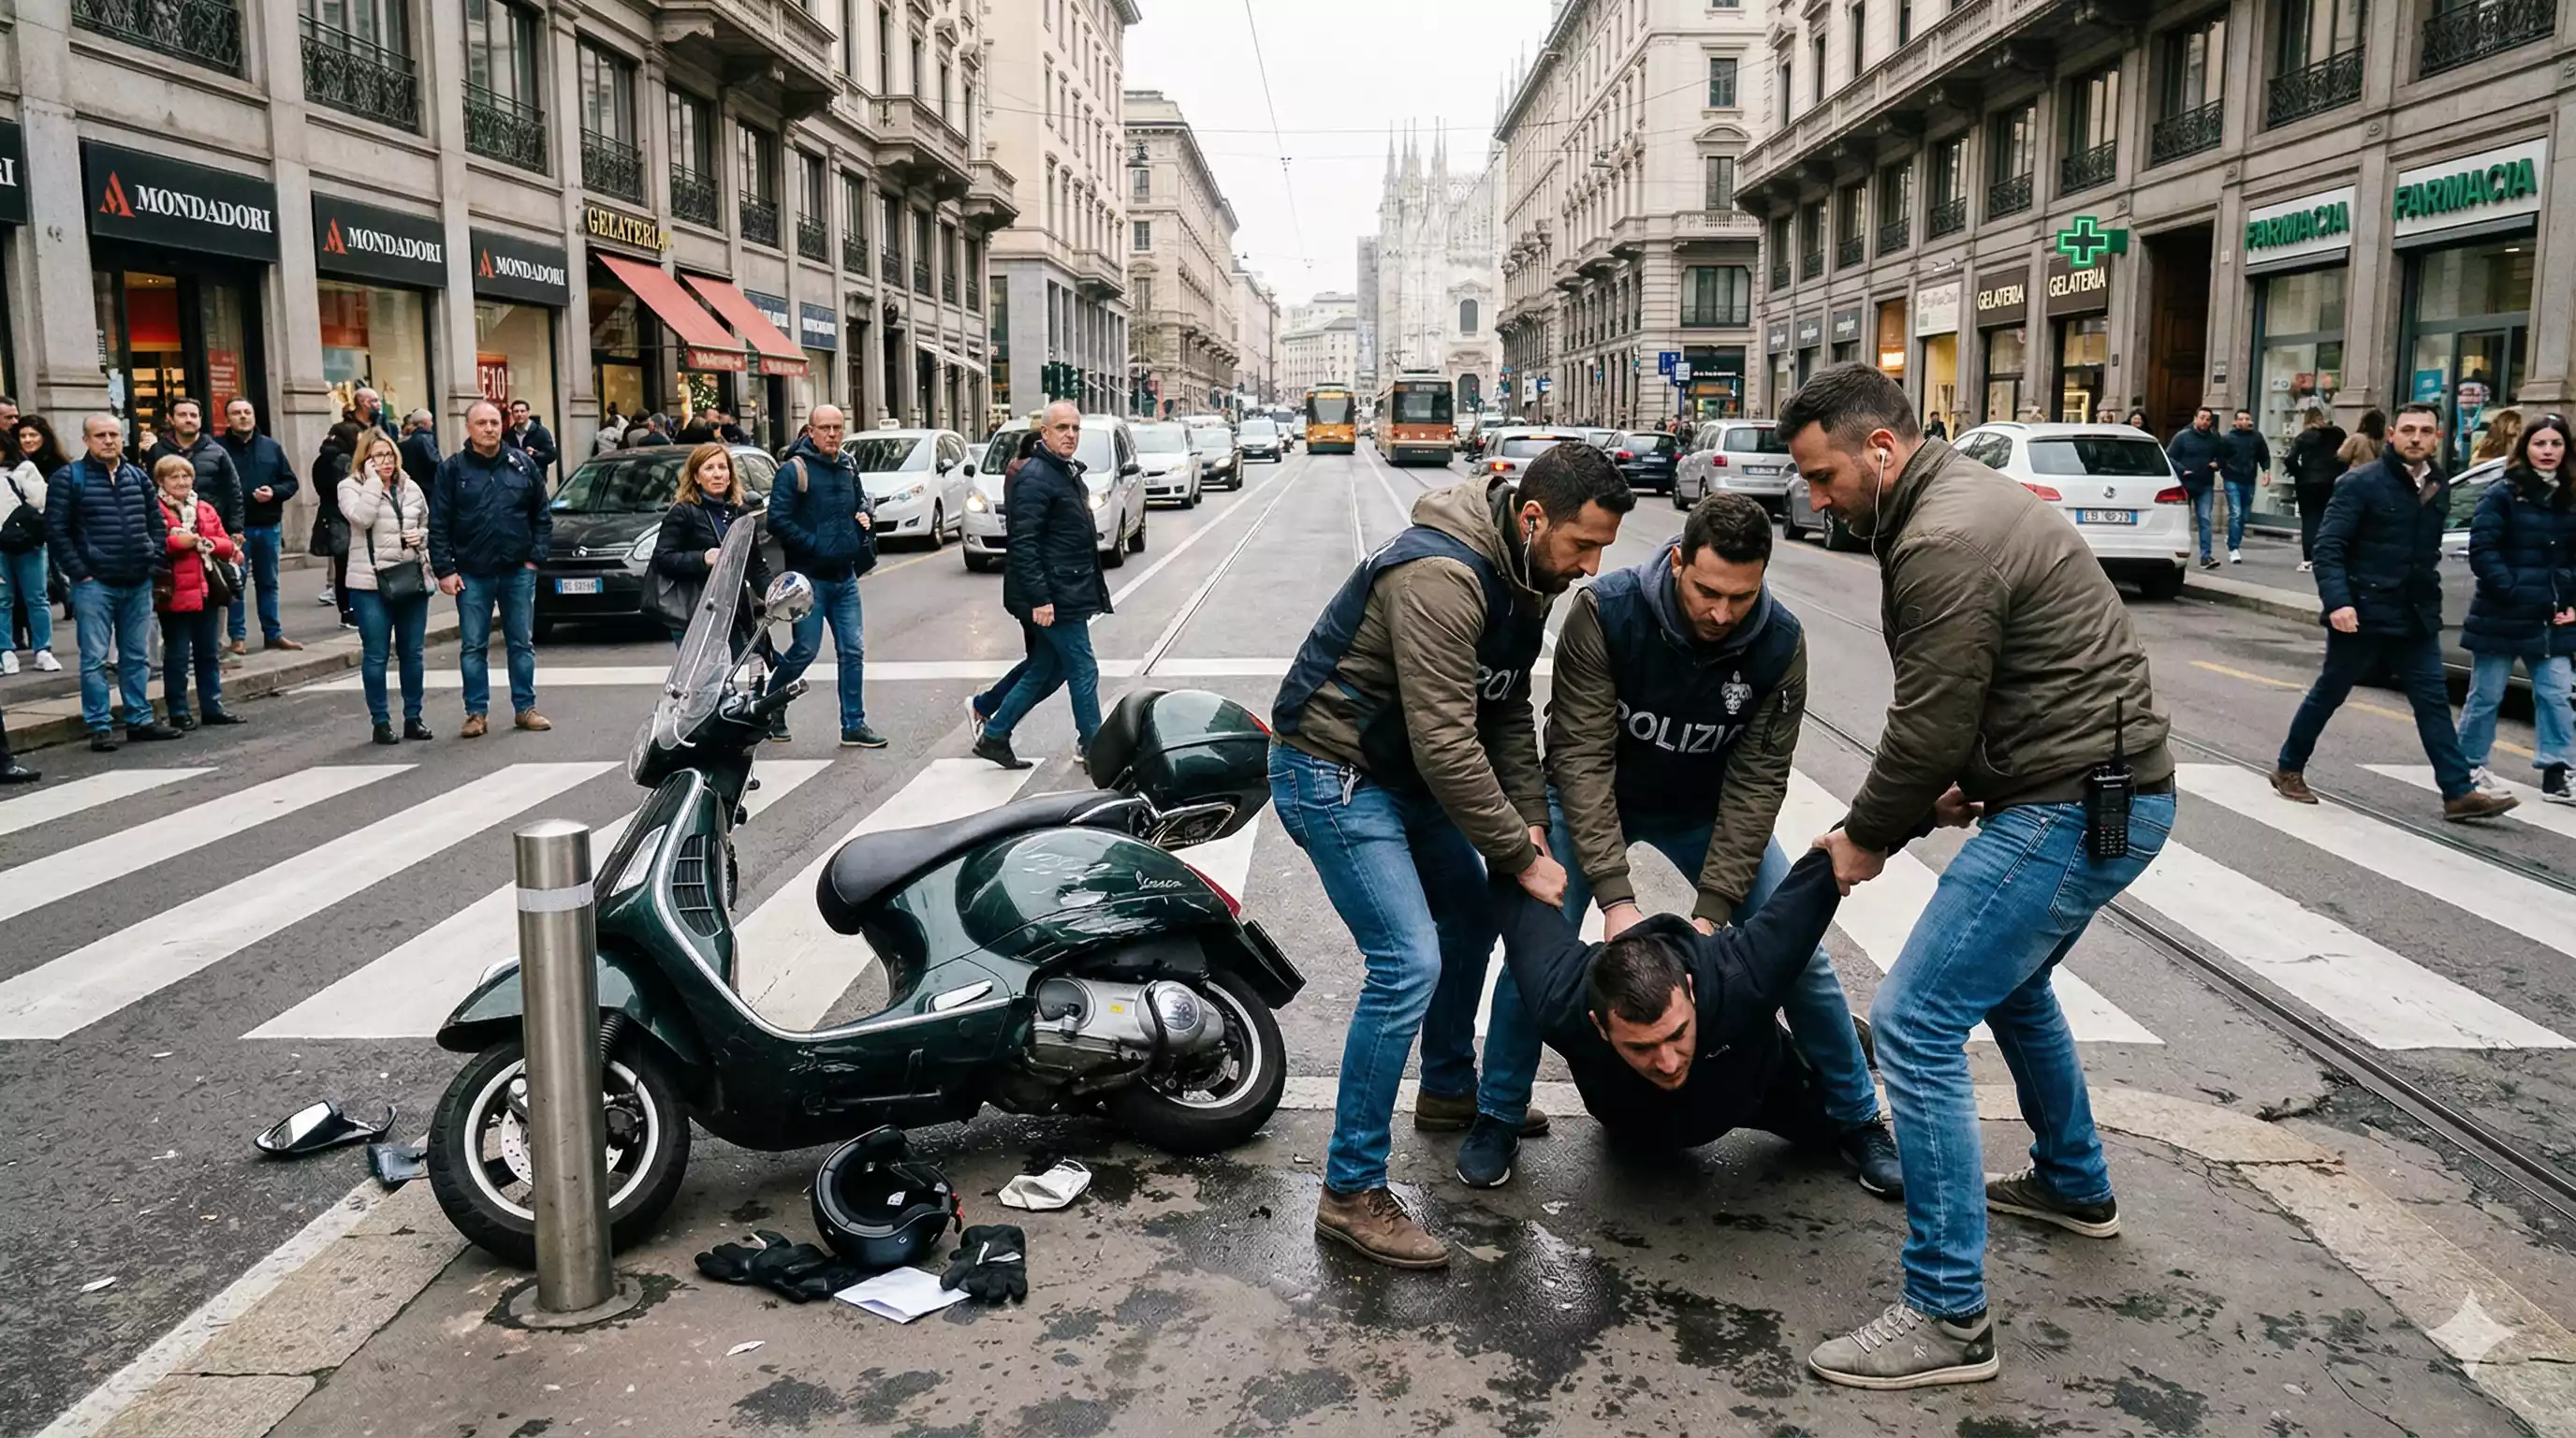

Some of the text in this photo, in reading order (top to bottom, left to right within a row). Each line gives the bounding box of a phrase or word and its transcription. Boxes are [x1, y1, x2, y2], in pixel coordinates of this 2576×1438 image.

[135, 184, 273, 233] MONDADORI
[2393, 157, 2538, 221] FARMACIA
[347, 227, 443, 263] MONDADORI
[588, 206, 666, 252] GELATERIA
[2245, 201, 2350, 250] FARMACIA
[495, 256, 565, 286] MONDADORI
[2049, 267, 2107, 297] GELATERIA
